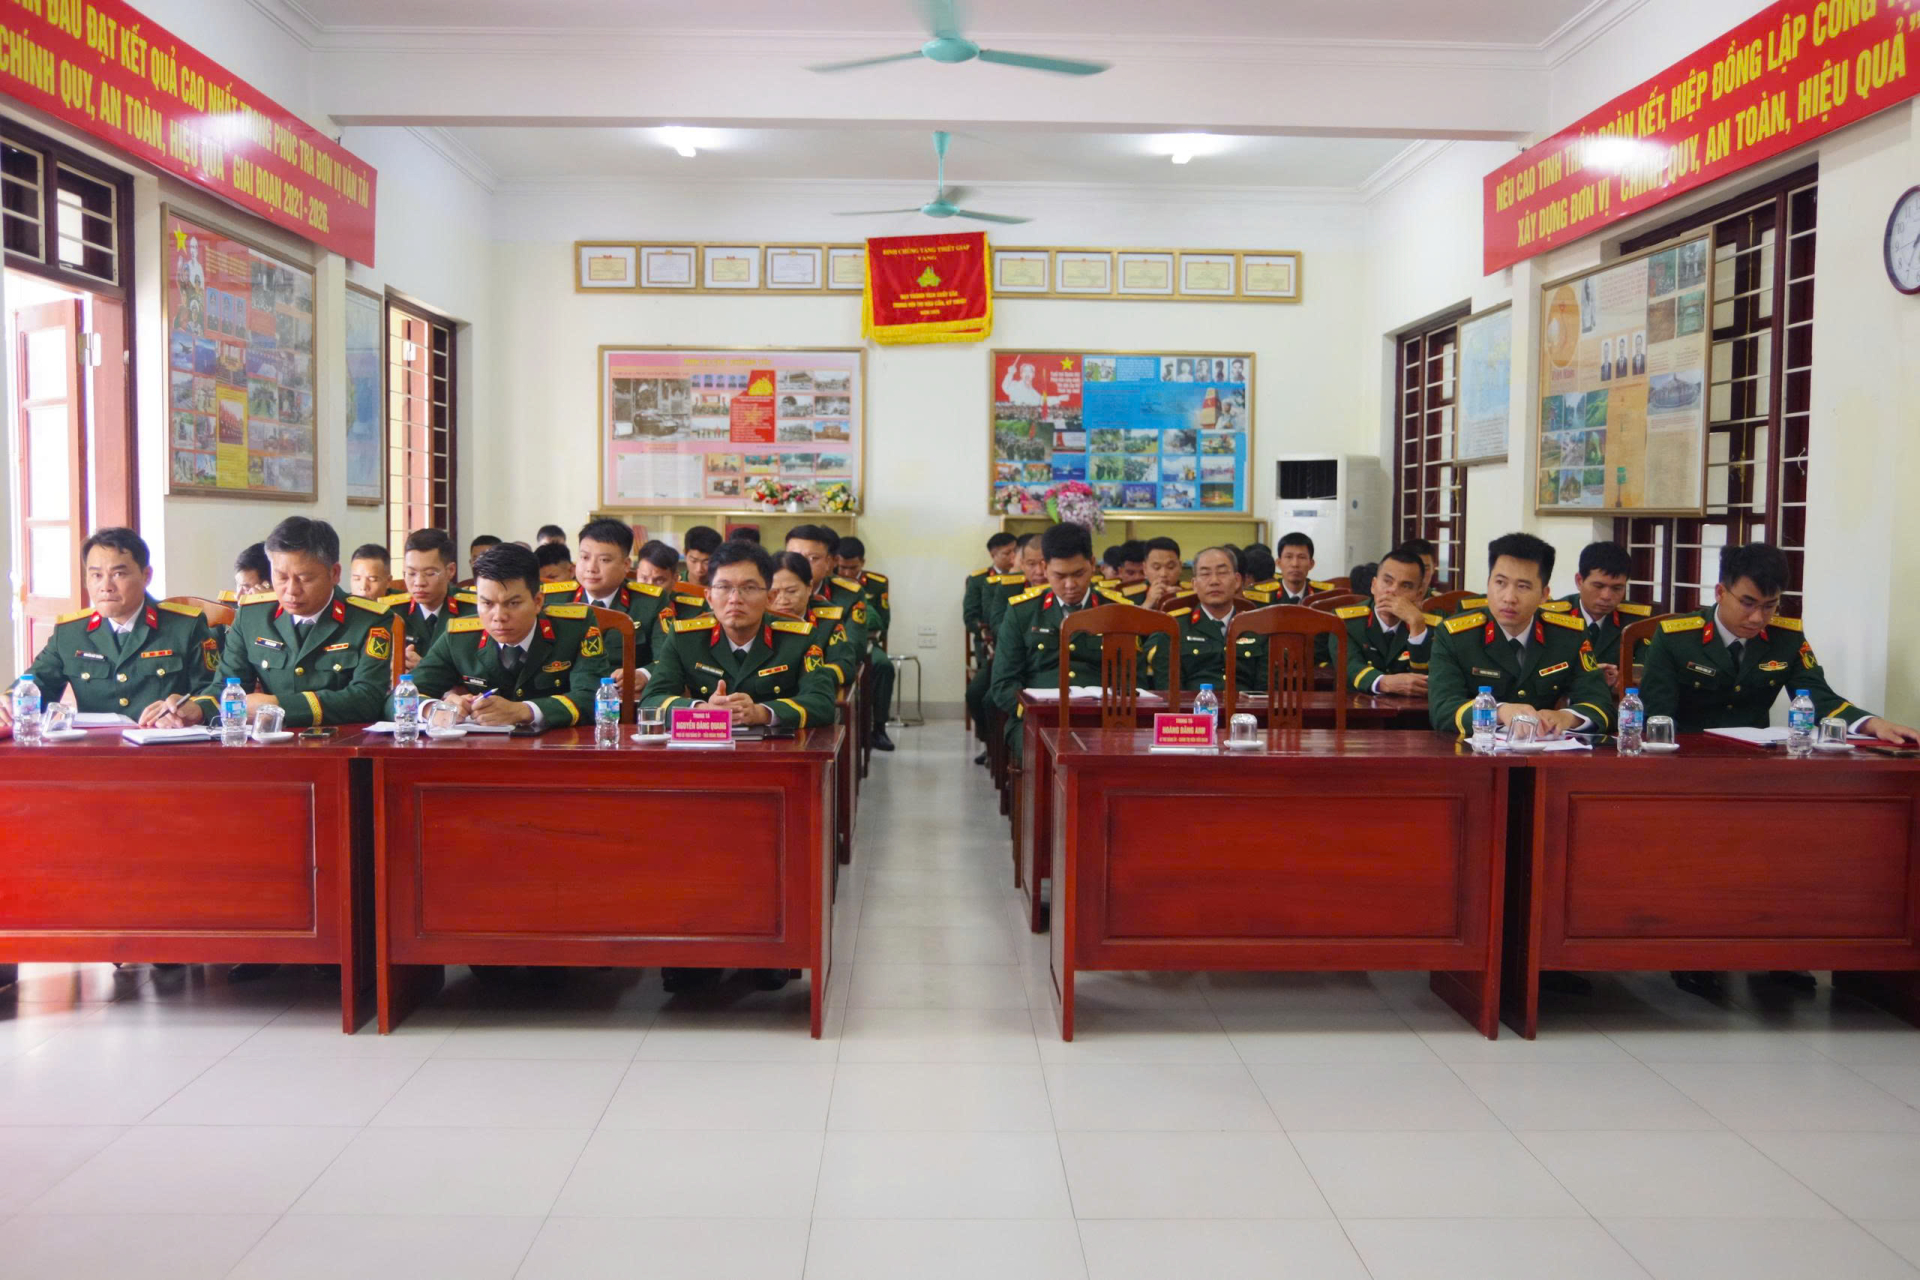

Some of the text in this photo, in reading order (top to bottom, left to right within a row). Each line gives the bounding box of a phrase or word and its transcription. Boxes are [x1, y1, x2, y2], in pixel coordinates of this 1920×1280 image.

[0, 24, 55, 96] CHÍNH
[60, 59, 96, 120] QUY,
[100, 80, 122, 130] AN
[125, 94, 166, 157] TOÀN,
[233, 153, 254, 196] GIAI
[256, 166, 282, 213] ĐOẠN
[283, 181, 303, 220] 2021
[86, 4, 117, 64] ĐẠT
[121, 23, 148, 78] KẾT
[150, 45, 178, 98] QUẢ
[181, 65, 205, 113] CAO
[299, 139, 315, 177] TRA
[1496, 174, 1515, 213] NÊU
[1516, 165, 1536, 201] CAO
[1538, 150, 1562, 191] TINH
[1638, 85, 1666, 139] KẾT,
[1670, 68, 1708, 123] HIỆP
[1712, 39, 1762, 101] ĐỒNG
[1767, 13, 1806, 74] LẬP
[1517, 209, 1537, 248] XÂY
[1539, 197, 1568, 242] DỰNG
[1570, 184, 1595, 225] ĐƠN
[1598, 176, 1610, 217] VỊ
[1667, 133, 1700, 184] QUY,
[1704, 118, 1731, 165] AN
[1735, 90, 1791, 151] TOÀN,
[1797, 58, 1849, 123] HIỆU
